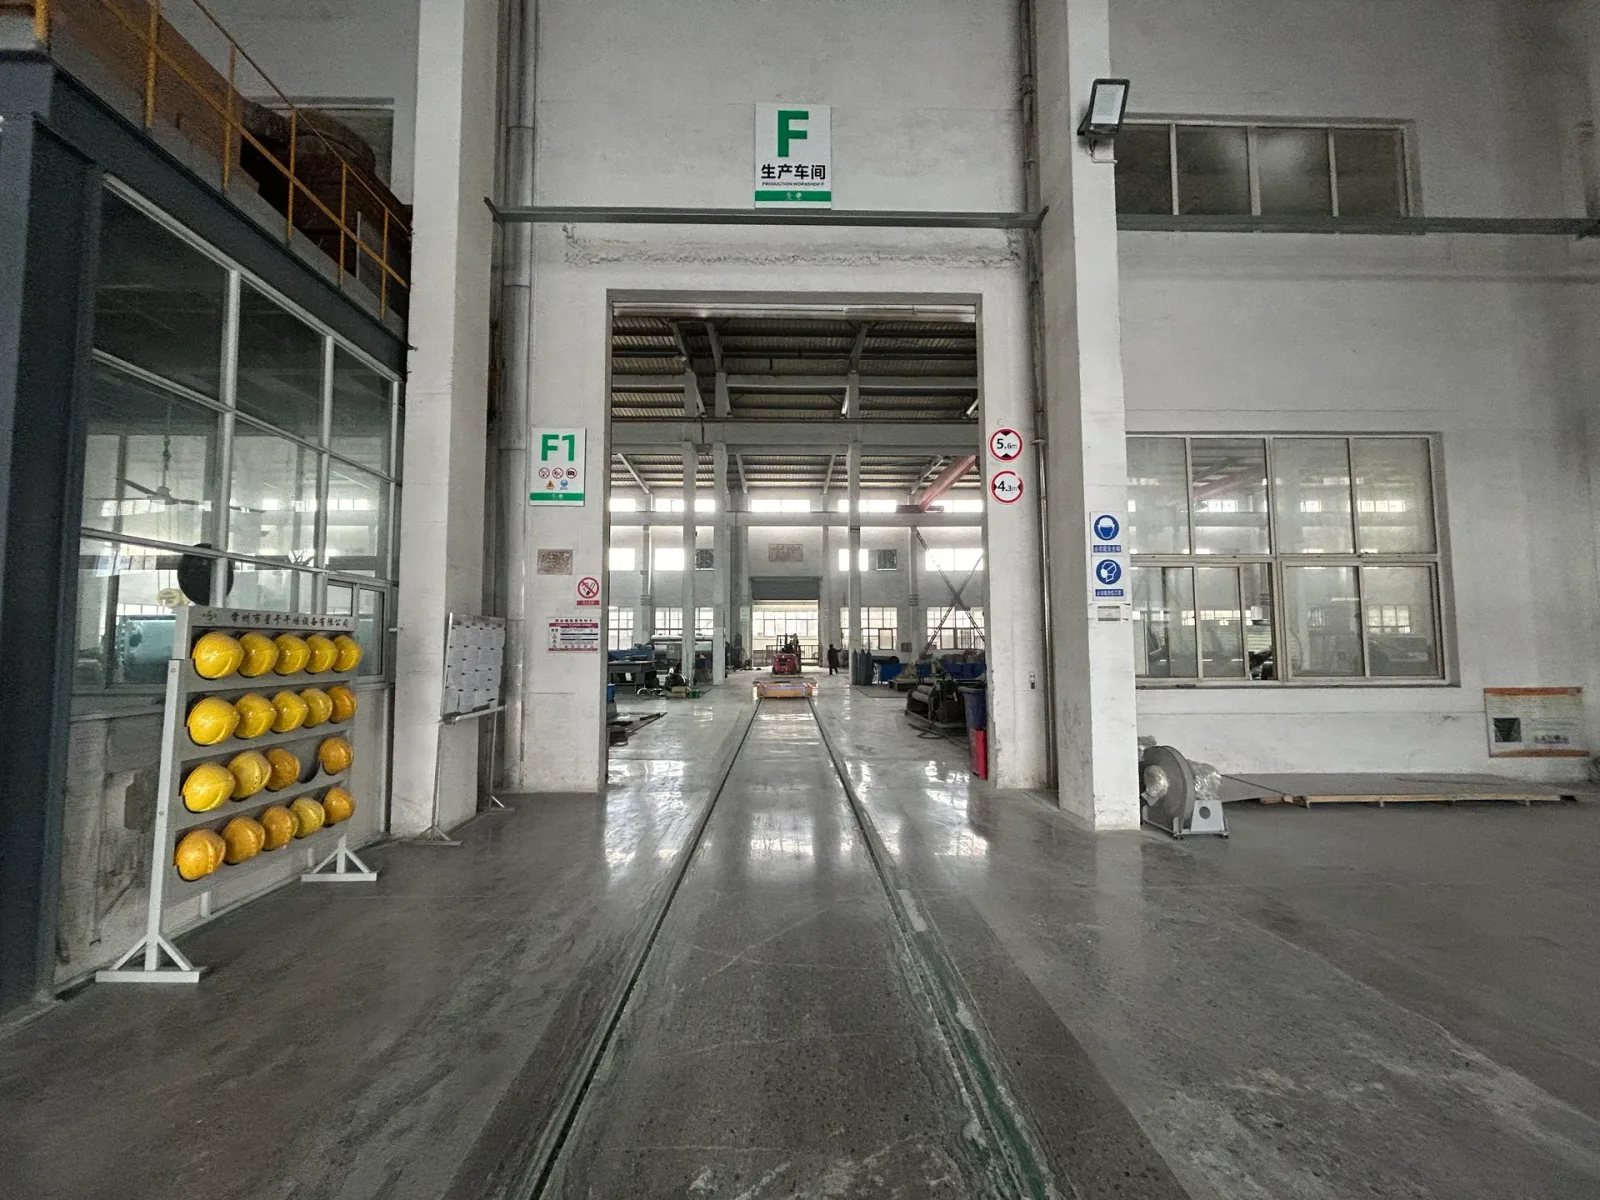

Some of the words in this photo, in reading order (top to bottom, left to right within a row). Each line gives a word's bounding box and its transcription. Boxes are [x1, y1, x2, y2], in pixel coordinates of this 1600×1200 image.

[777, 110, 809, 157] F
[761, 163, 826, 180] 生产车间
[541, 434, 575, 461] F1
[996, 438, 1018, 450] 5.6m
[997, 480, 1018, 492] 4.3m
